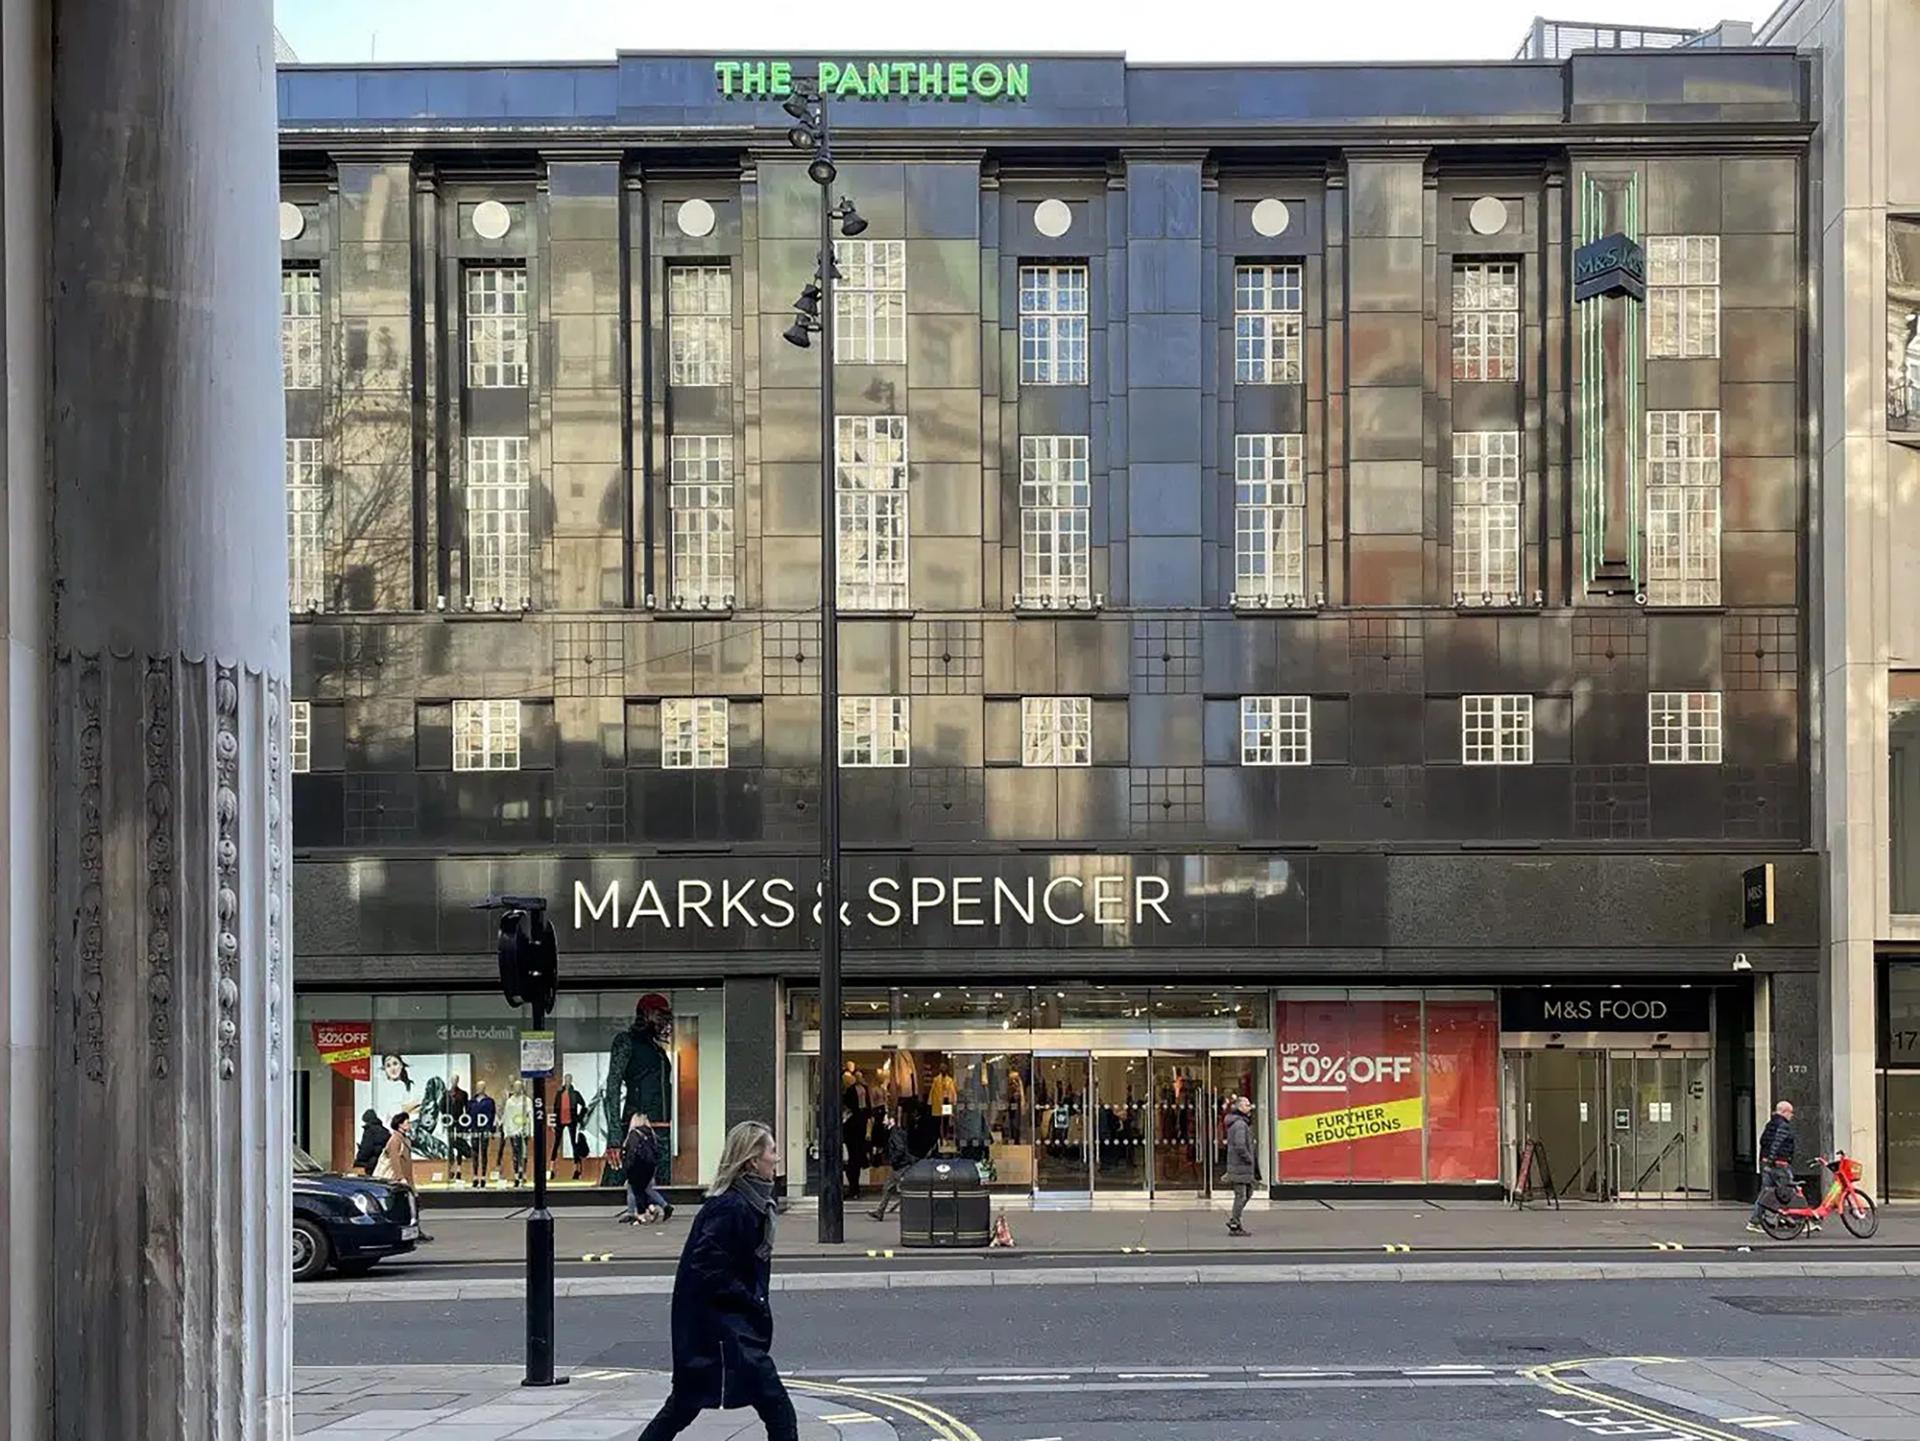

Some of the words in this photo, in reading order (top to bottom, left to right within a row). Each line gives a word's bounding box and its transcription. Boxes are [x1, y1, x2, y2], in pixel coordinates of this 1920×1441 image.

[715, 62, 792, 94] THE
[818, 62, 1028, 96] PANTHEON
[1577, 247, 1617, 276] M&S
[574, 878, 796, 929] MARKS
[866, 876, 1172, 926] SPENCER
[1544, 1000, 1592, 1019] M&S
[1600, 1000, 1667, 1019] FOOD
[1280, 1043, 1299, 1054] UP
[1300, 1043, 1320, 1054] TO
[1282, 1056, 1347, 1083] 50%
[1349, 1056, 1412, 1083] OFF
[1788, 1065, 1808, 1073] 173
[1305, 1118, 1401, 1144] REDUCTIONS
[1317, 1108, 1385, 1129] FURTHER
